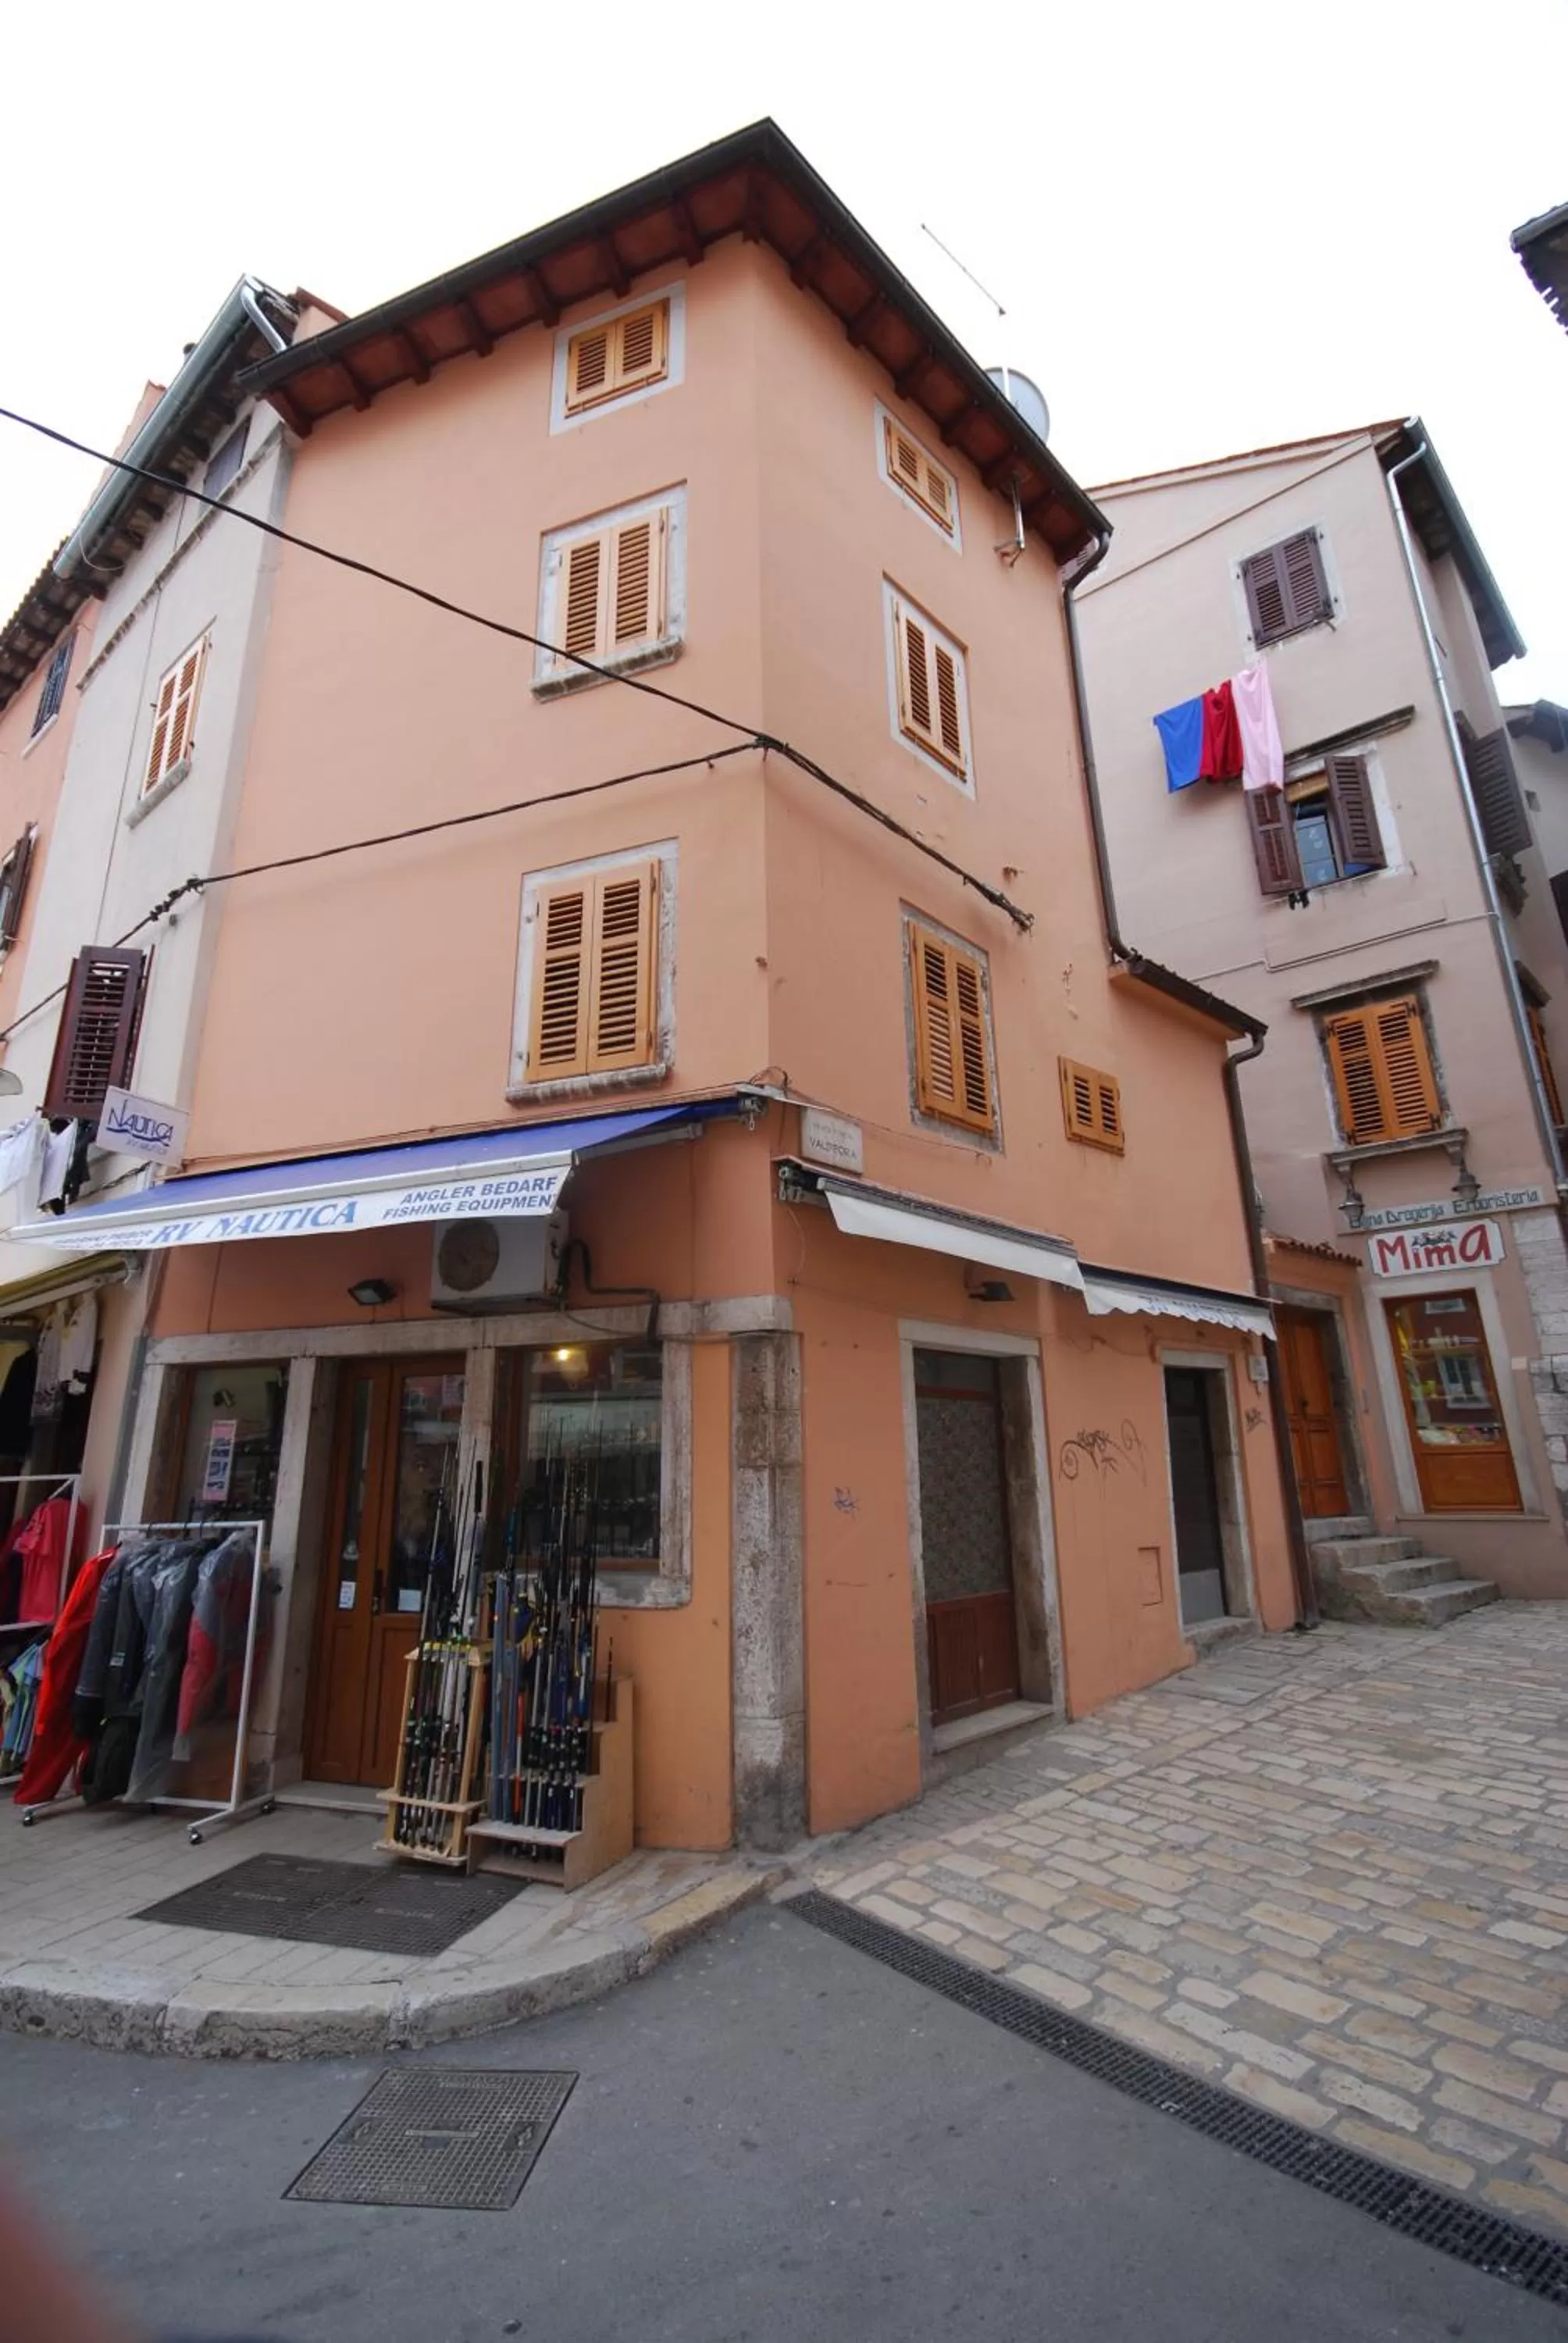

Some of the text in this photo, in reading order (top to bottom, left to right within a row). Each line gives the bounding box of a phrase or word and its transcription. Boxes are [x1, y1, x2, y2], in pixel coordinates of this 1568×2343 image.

[400, 1176, 558, 1205] ANGLER BEDARF
[206, 1200, 358, 1238] NAUTICA
[383, 1202, 452, 1220] FISHING
